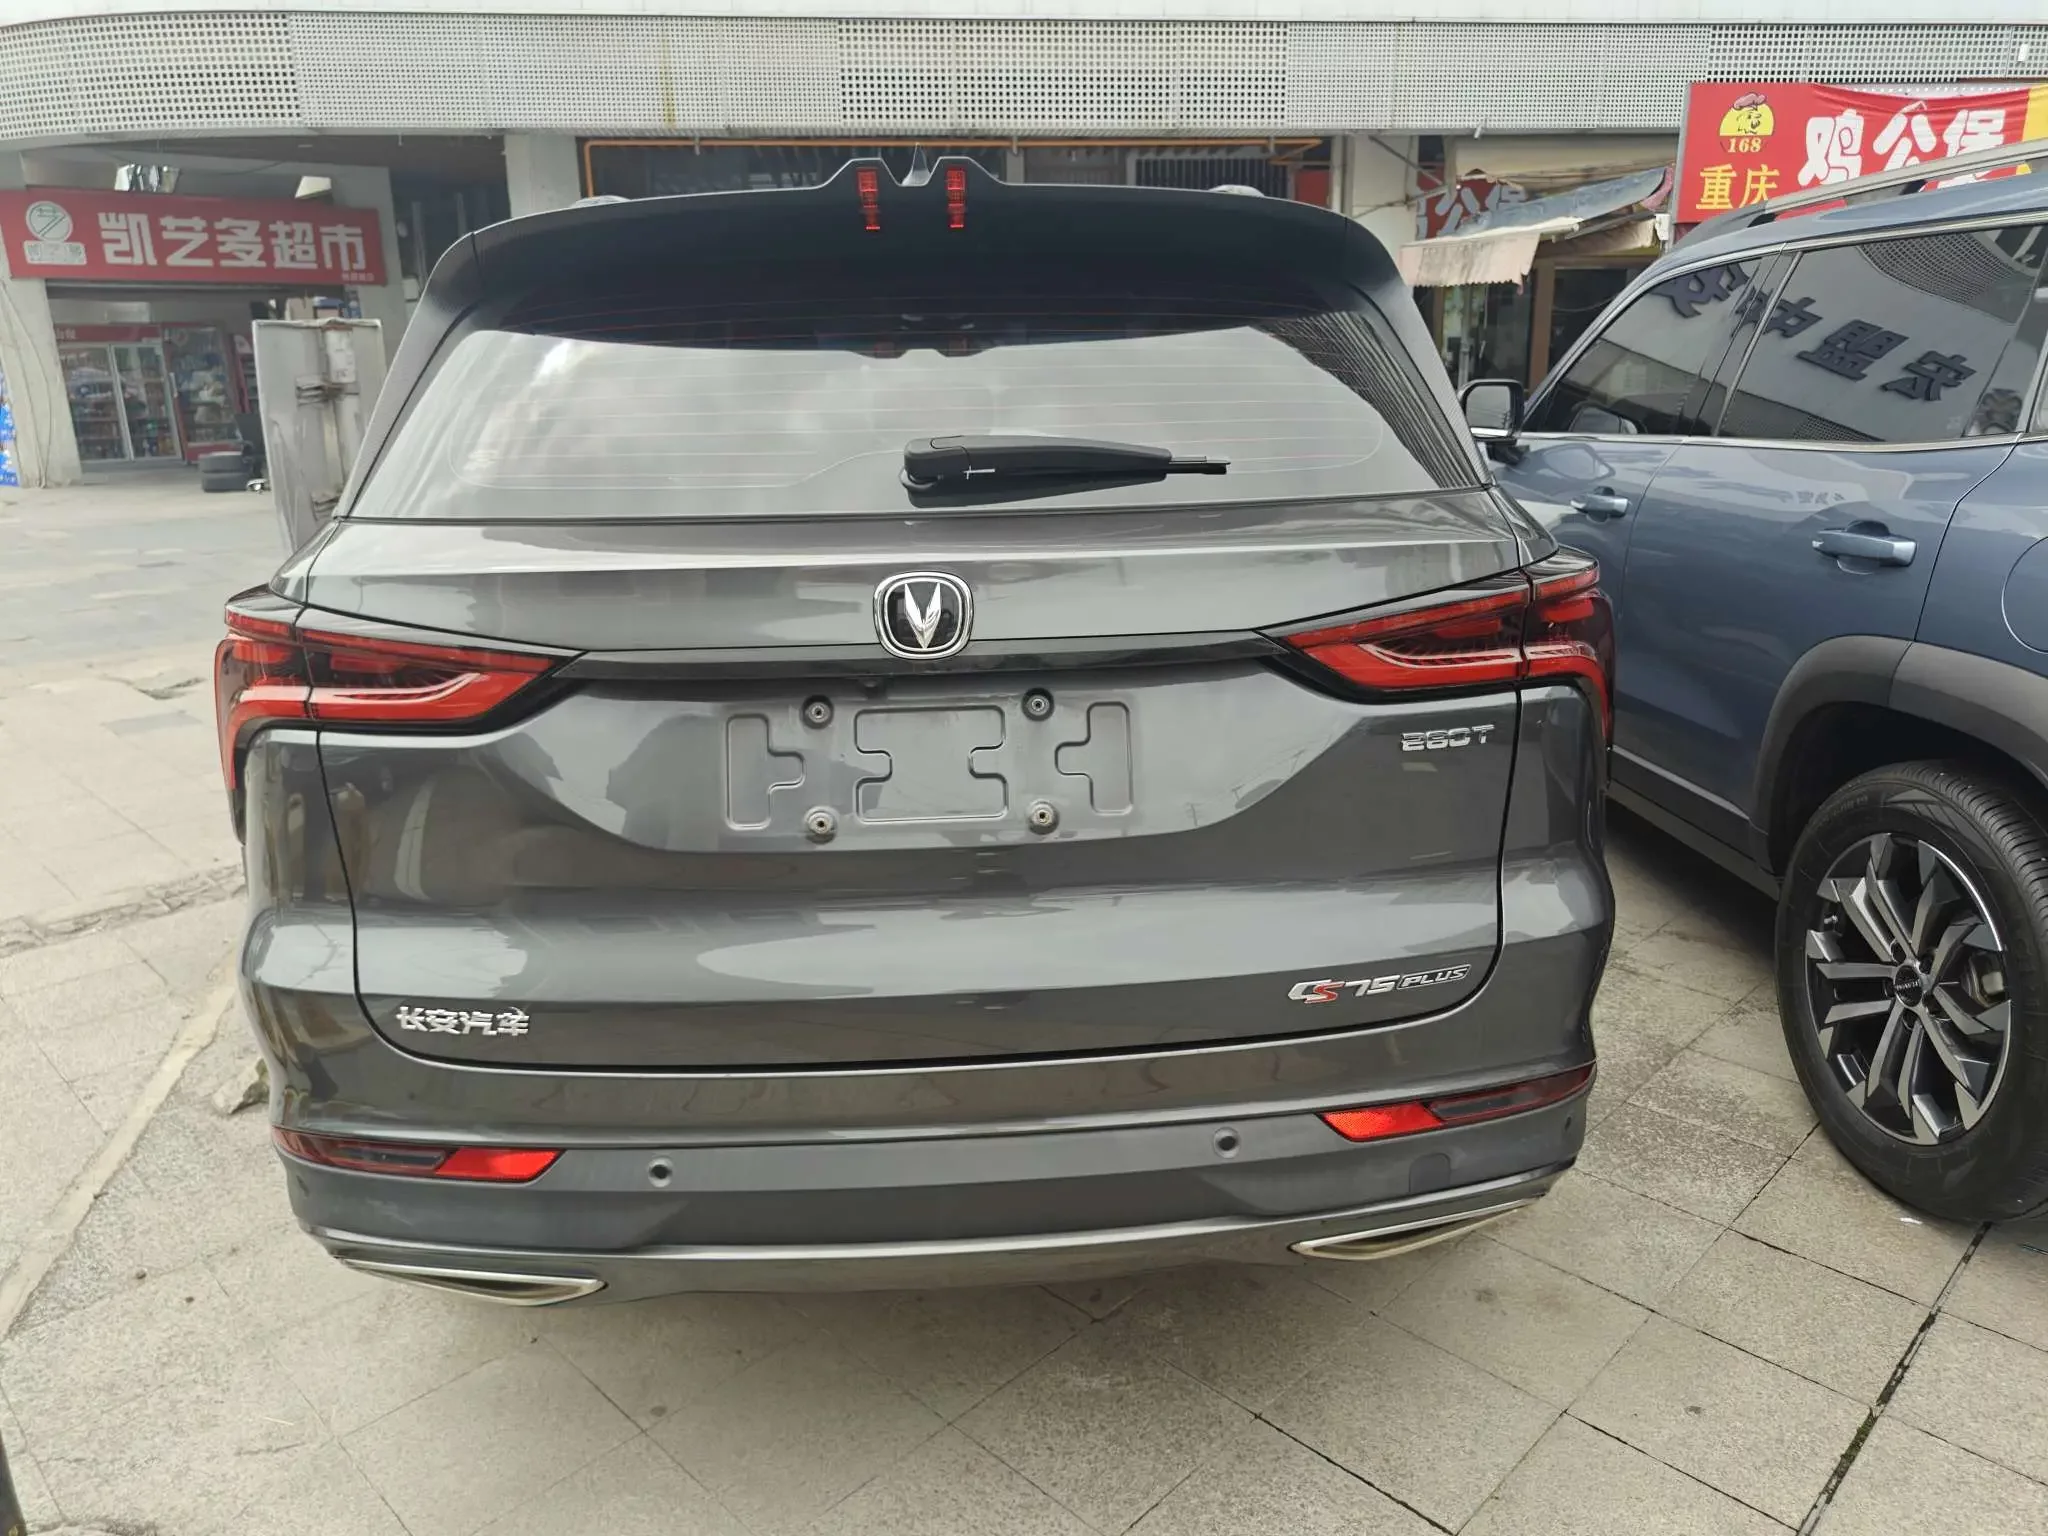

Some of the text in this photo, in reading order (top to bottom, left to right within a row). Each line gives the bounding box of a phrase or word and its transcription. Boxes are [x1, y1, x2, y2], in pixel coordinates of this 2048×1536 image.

[1727, 136, 1762, 153] 168
[1696, 163, 1780, 209] 重庆
[97, 212, 367, 271] 凯艺多超市
[1287, 966, 1469, 1004] CS75 PLUS
[396, 1006, 530, 1036] 长安汽车
